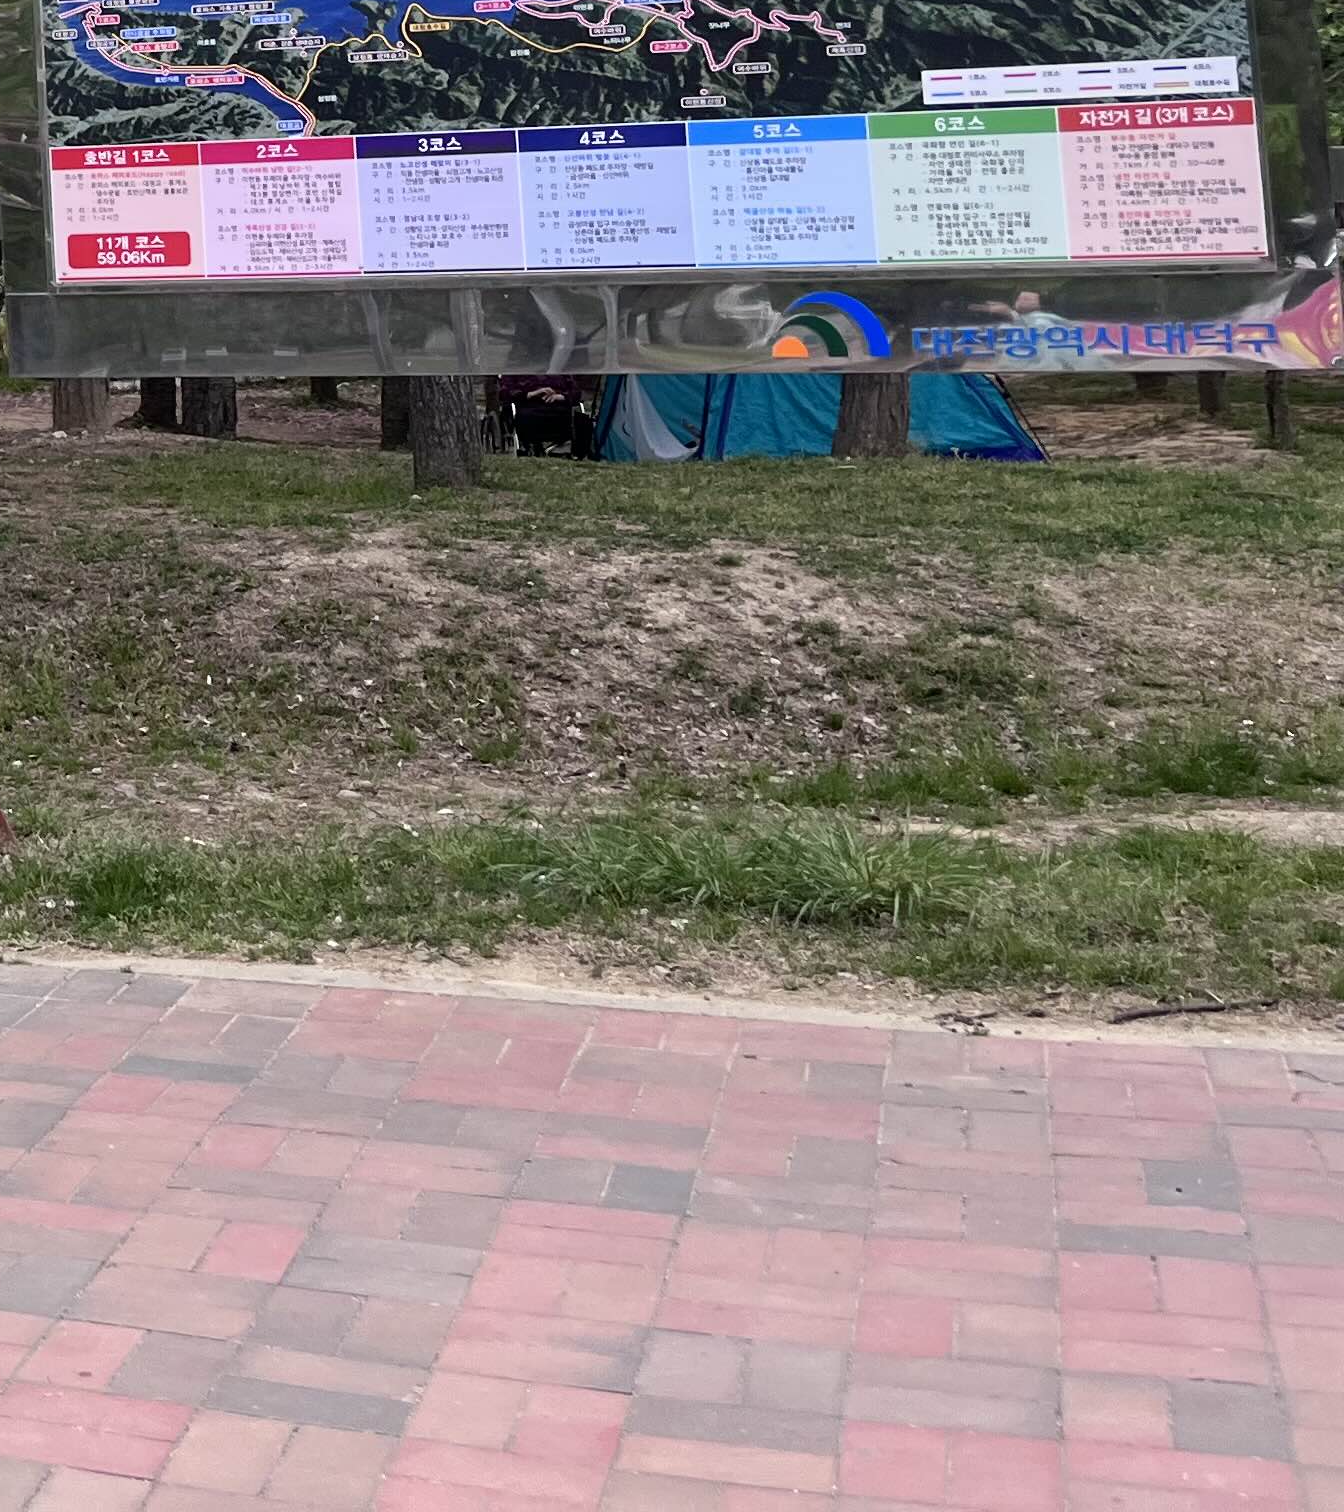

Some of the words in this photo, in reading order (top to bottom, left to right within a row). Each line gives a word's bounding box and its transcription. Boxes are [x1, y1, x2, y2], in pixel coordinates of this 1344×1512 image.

[934, 115, 985, 132] 6코스
[1079, 108, 1130, 127] 자전거
[1135, 107, 1152, 124] 길
[1155, 105, 1188, 124] (3개
[1192, 104, 1235, 123] 코스)
[579, 129, 626, 145] 4코스
[752, 122, 802, 139] 5코스
[255, 143, 300, 159] 2코스
[417, 136, 463, 153] 3코스
[83, 149, 127, 166] 호반길
[132, 148, 171, 164] 1코스
[96, 235, 129, 250] 11개
[135, 235, 165, 249] 코스
[97, 251, 165, 266] 59.06Km
[912, 322, 1130, 360] 대전광역시
[1144, 320, 1280, 355] 대덕구
